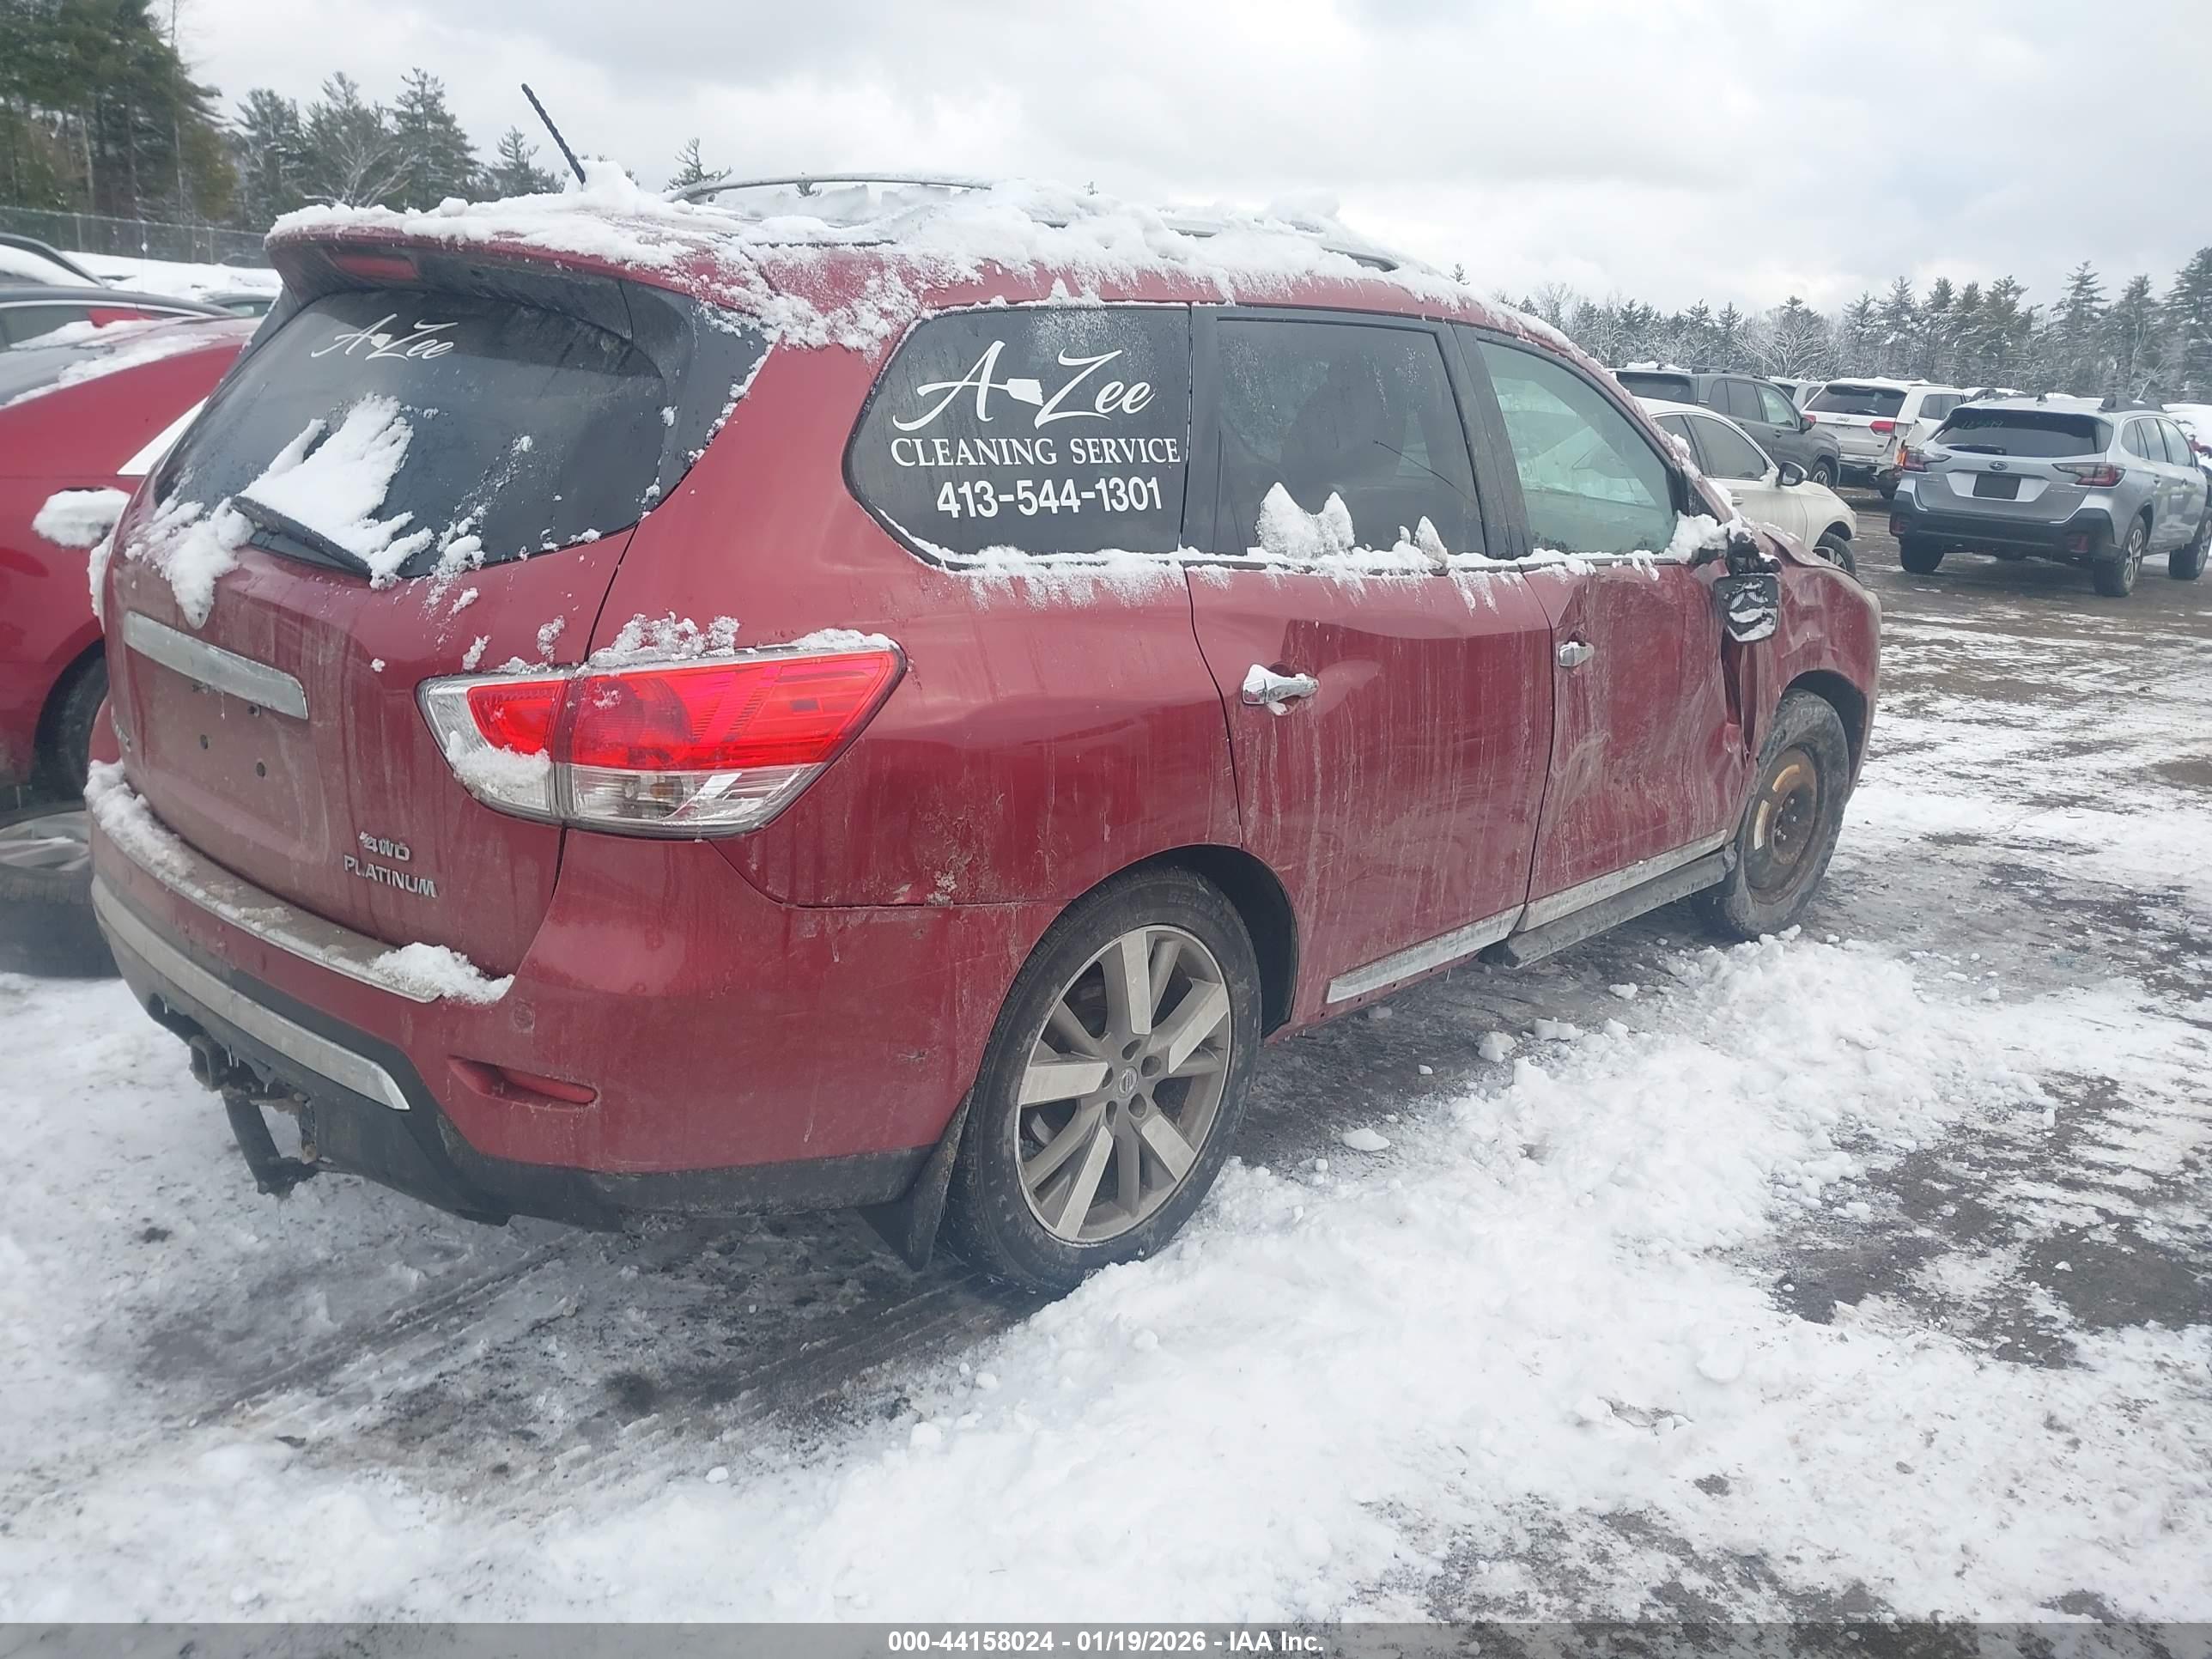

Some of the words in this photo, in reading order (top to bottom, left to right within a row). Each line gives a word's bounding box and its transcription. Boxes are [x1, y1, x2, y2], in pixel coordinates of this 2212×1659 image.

[890, 437, 1058, 467] CLEANING
[1070, 437, 1181, 465] SERVICE
[936, 477, 1163, 519] 413-544-1301
[362, 835, 410, 861] 4WD
[343, 854, 439, 898] PLATINUM
